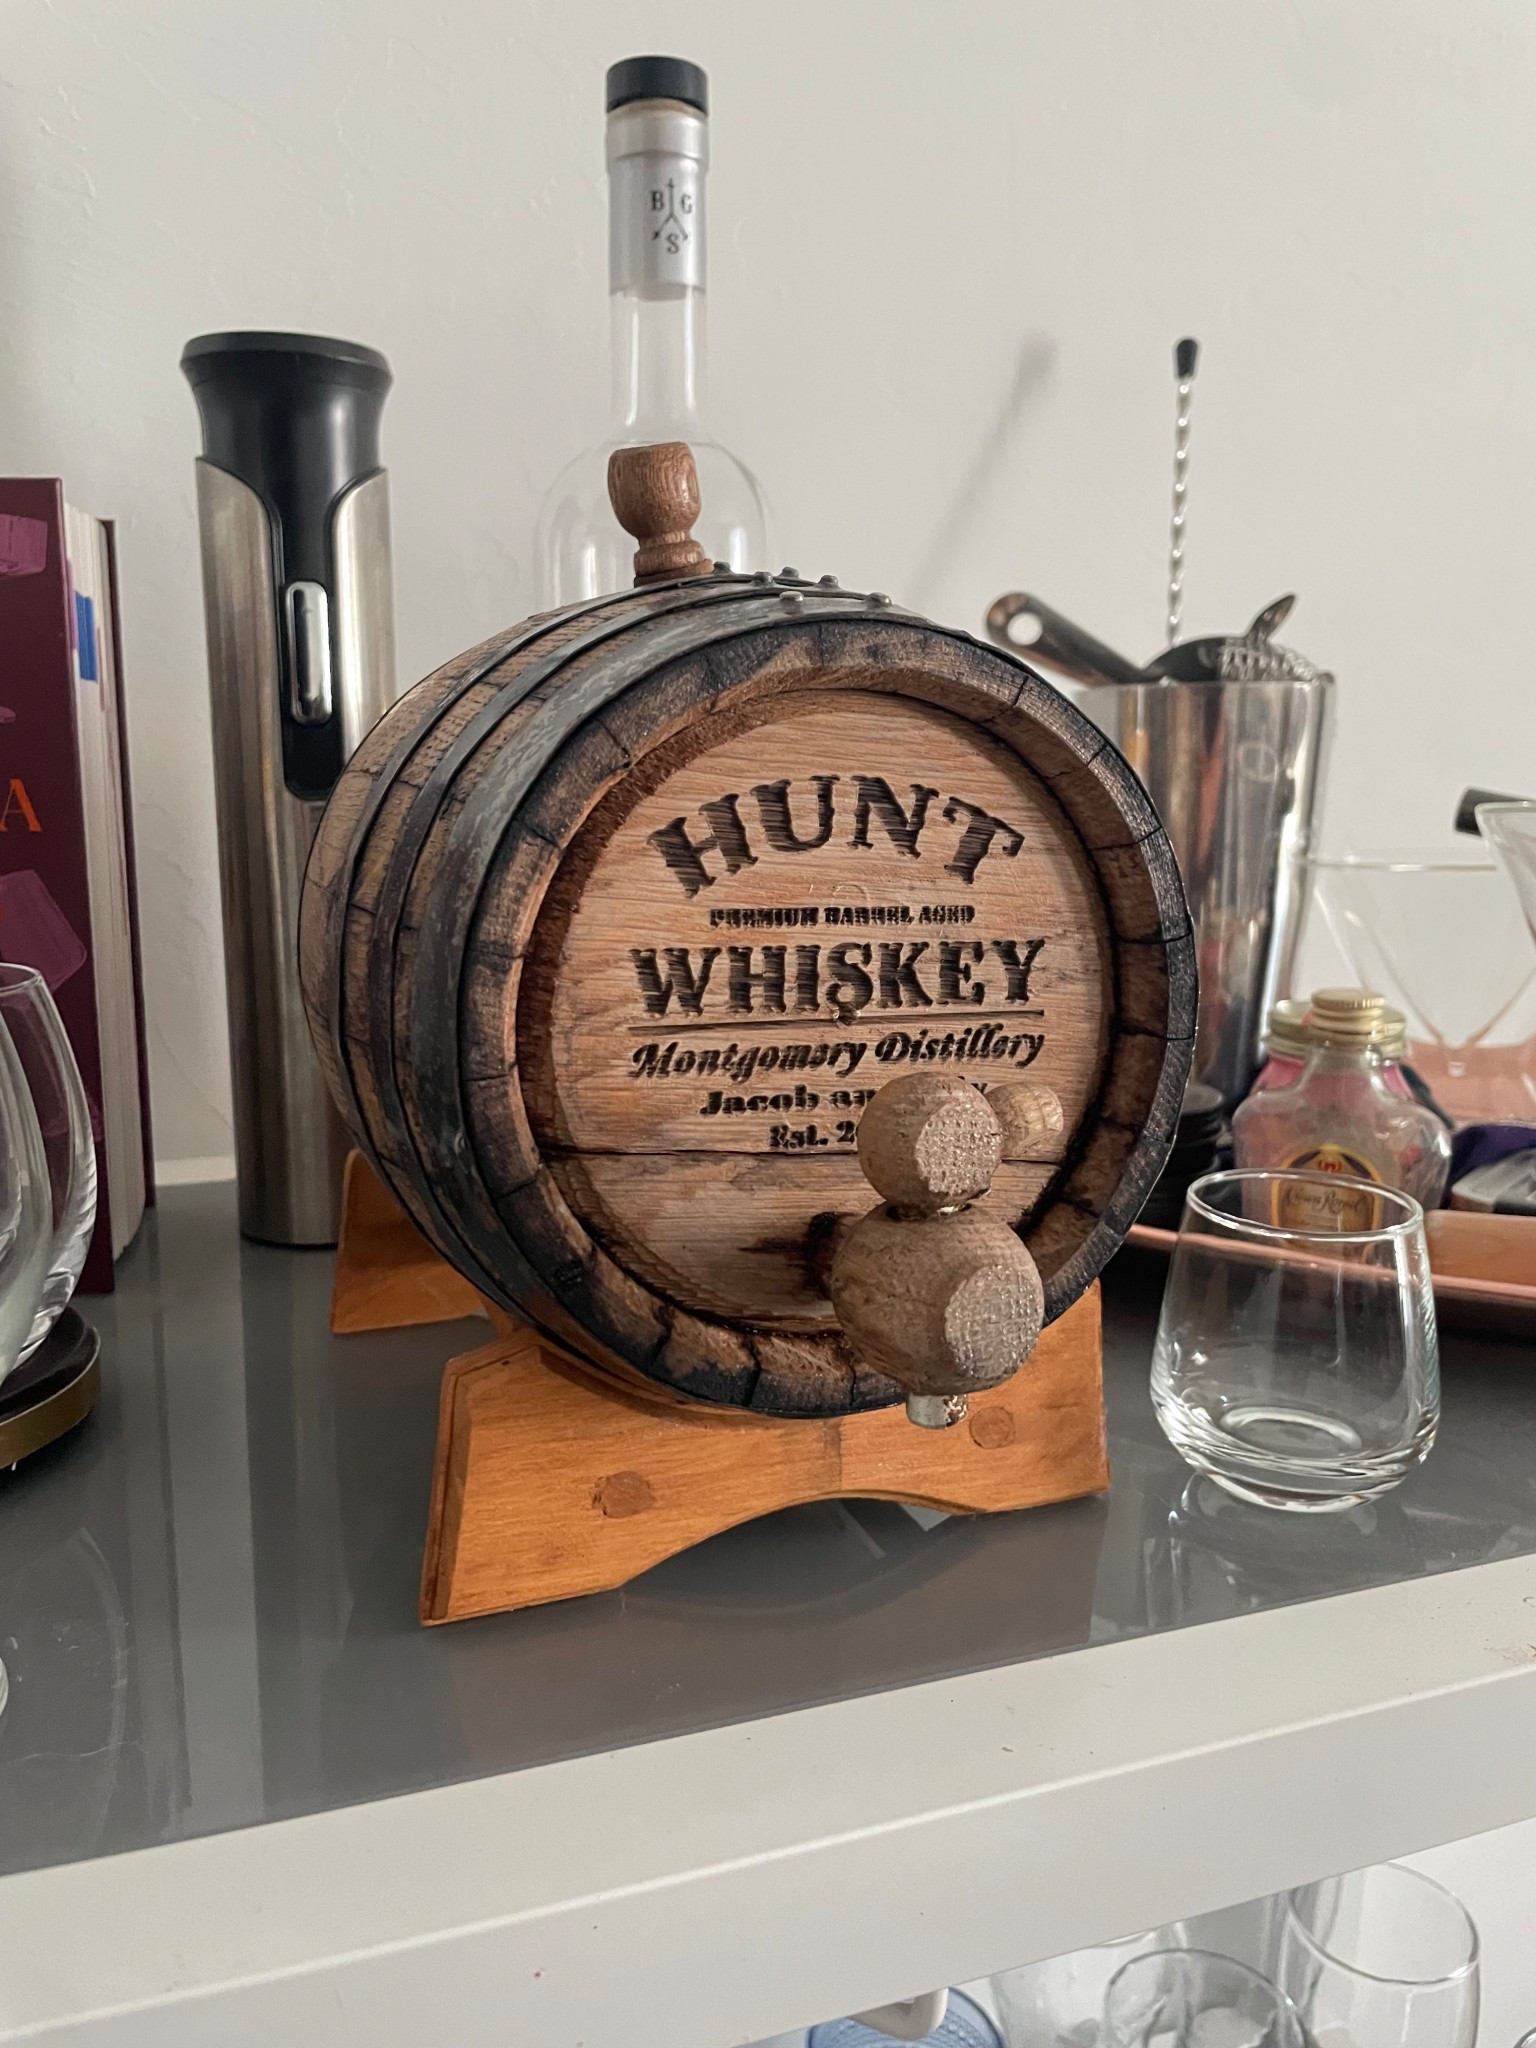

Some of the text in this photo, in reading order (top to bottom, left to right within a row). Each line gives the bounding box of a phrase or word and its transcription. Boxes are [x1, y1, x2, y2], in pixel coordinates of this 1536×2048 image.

[651, 190, 664, 211] B
[666, 233, 680, 254] S
[647, 774, 1026, 899] HUNT
[709, 904, 976, 929] PREMIUM BARREL AGED
[629, 939, 1046, 1018] WHISKEY
[874, 1022, 1046, 1068] Distillery
[700, 1083, 821, 1115] Jacob
[769, 1124, 829, 1150] Est.
